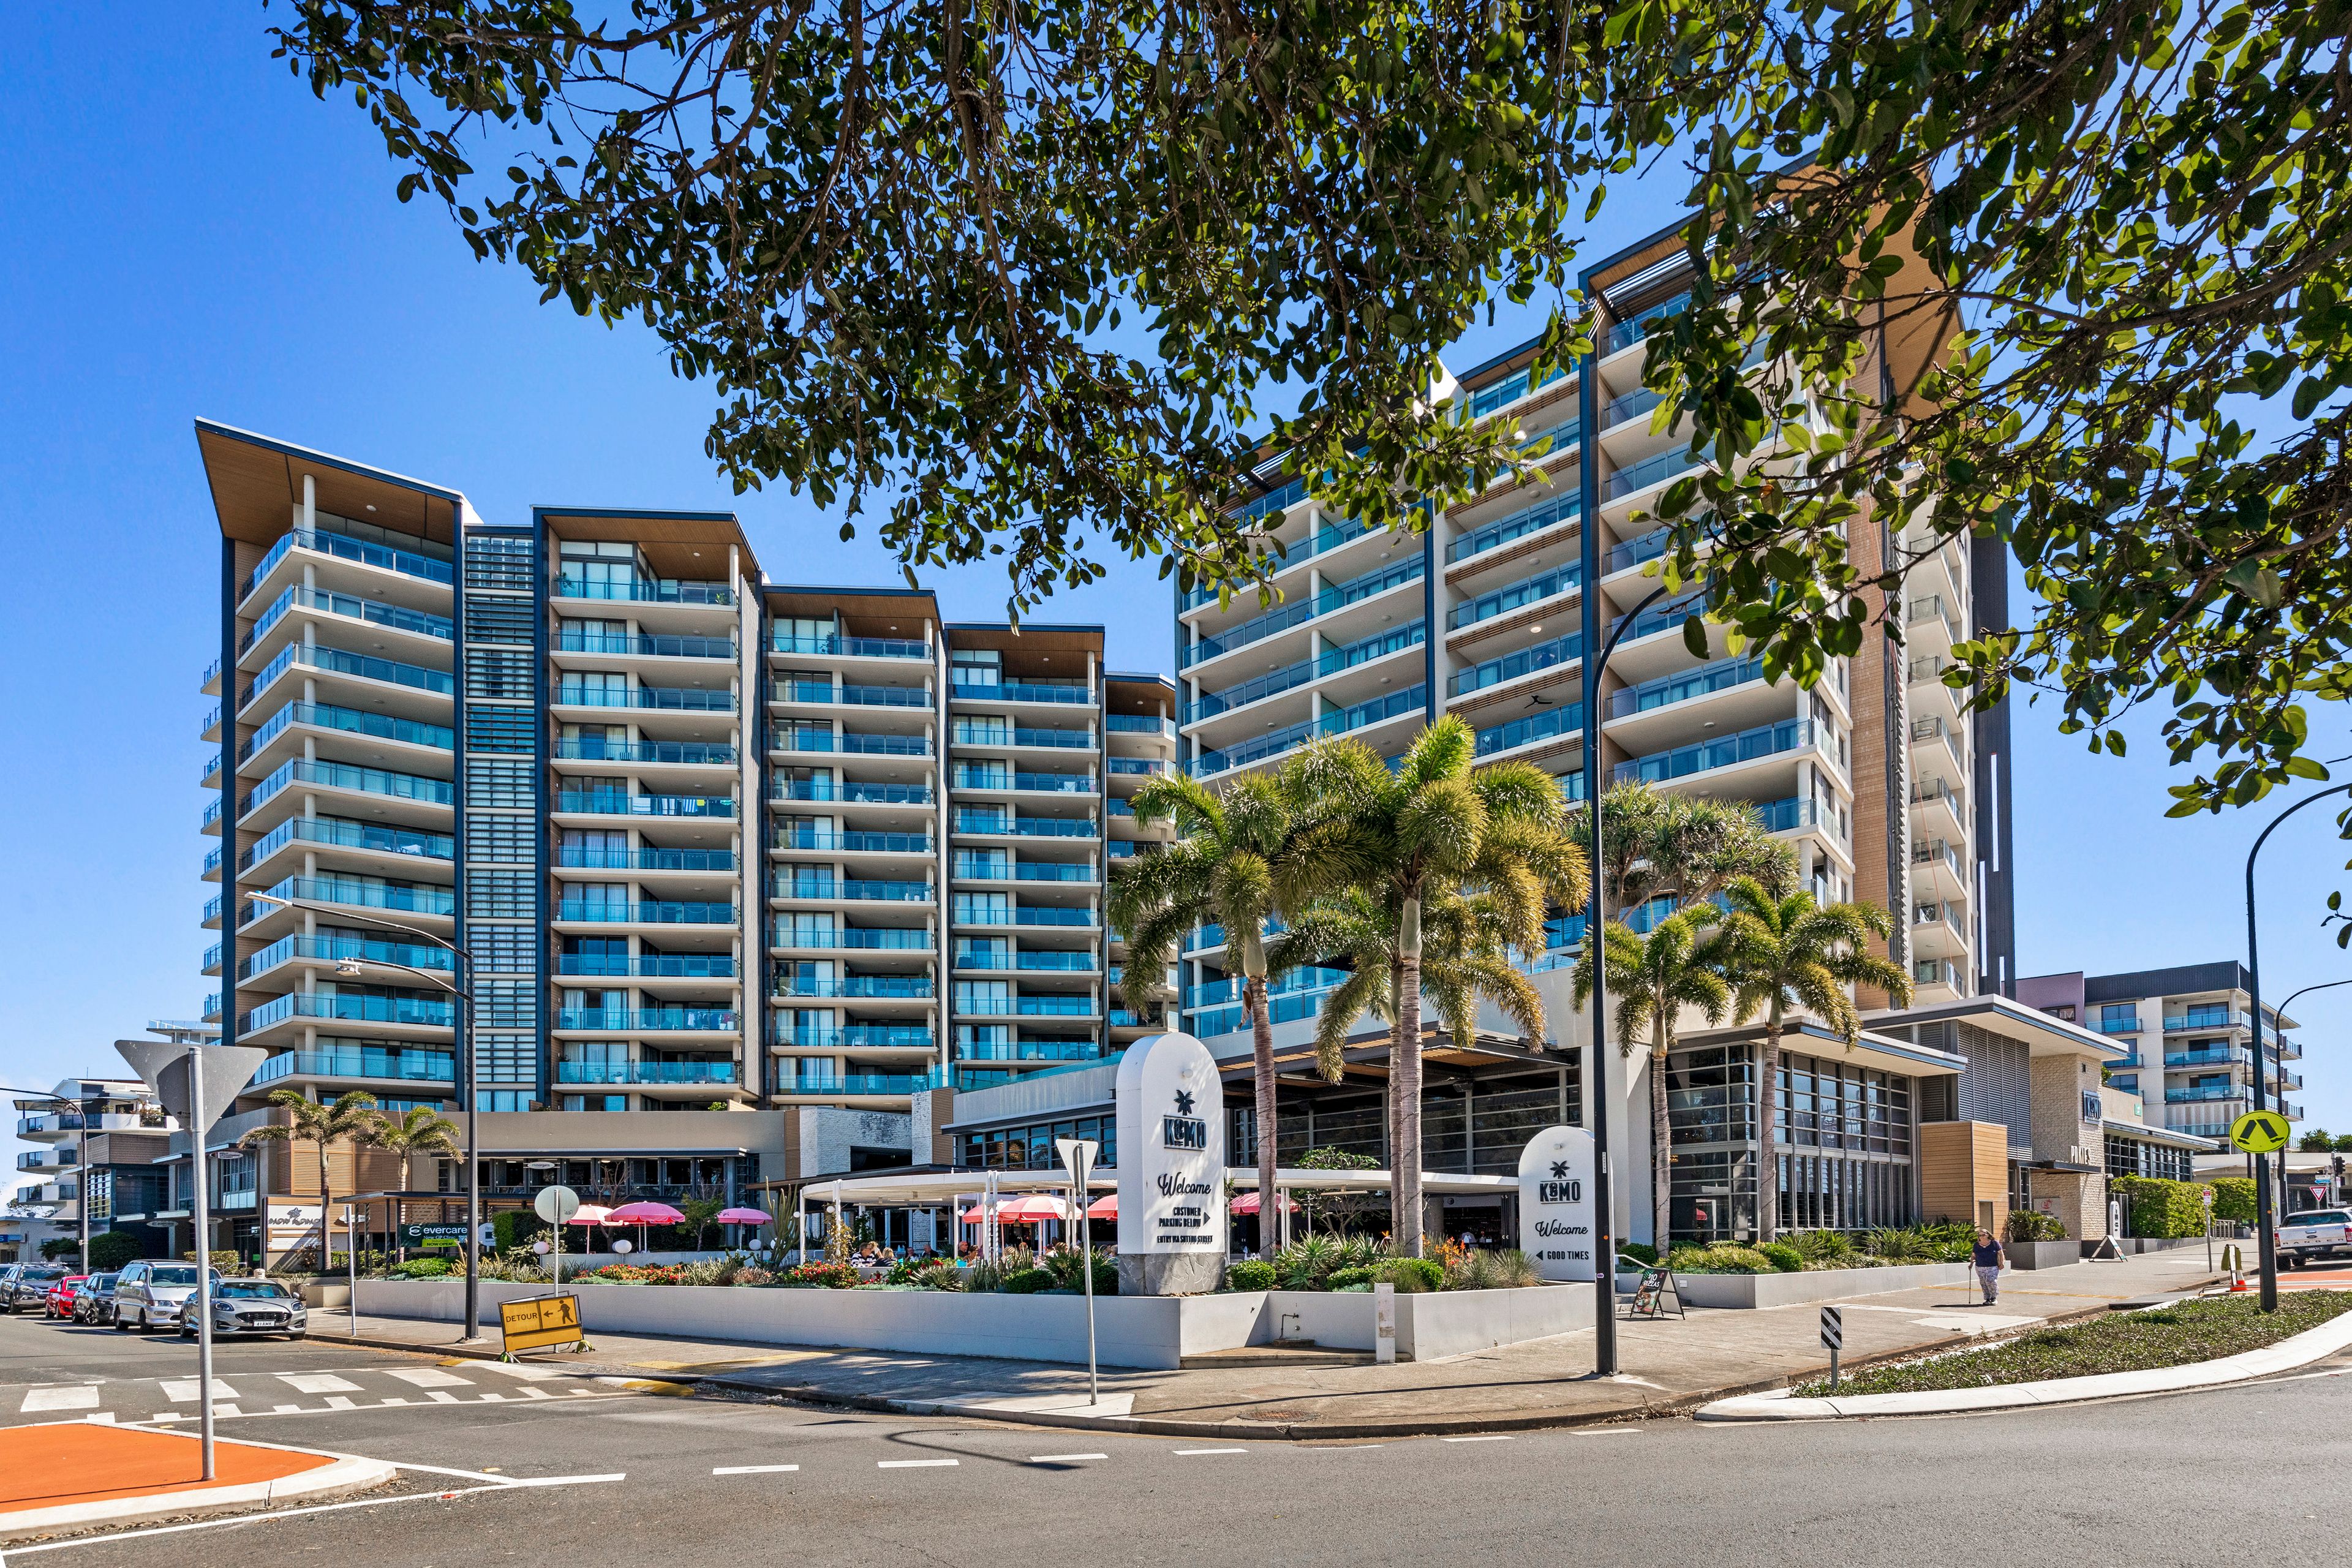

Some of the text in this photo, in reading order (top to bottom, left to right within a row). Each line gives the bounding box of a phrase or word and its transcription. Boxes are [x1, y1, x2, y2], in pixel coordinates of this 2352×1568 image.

[1164, 1118, 1207, 1148] KOMO
[2071, 1145, 2090, 1165] POKIES
[1158, 1172, 1212, 1196] Welcome
[1539, 1181, 1581, 1202] KOMO
[1173, 1207, 1201, 1216] CUSTOMER
[1159, 1218, 1201, 1227] PARKING BELOW
[1535, 1219, 1588, 1237] Welcome
[1547, 1251, 1589, 1260] GOOD TIMES
[505, 1313, 538, 1322] DETOUR
